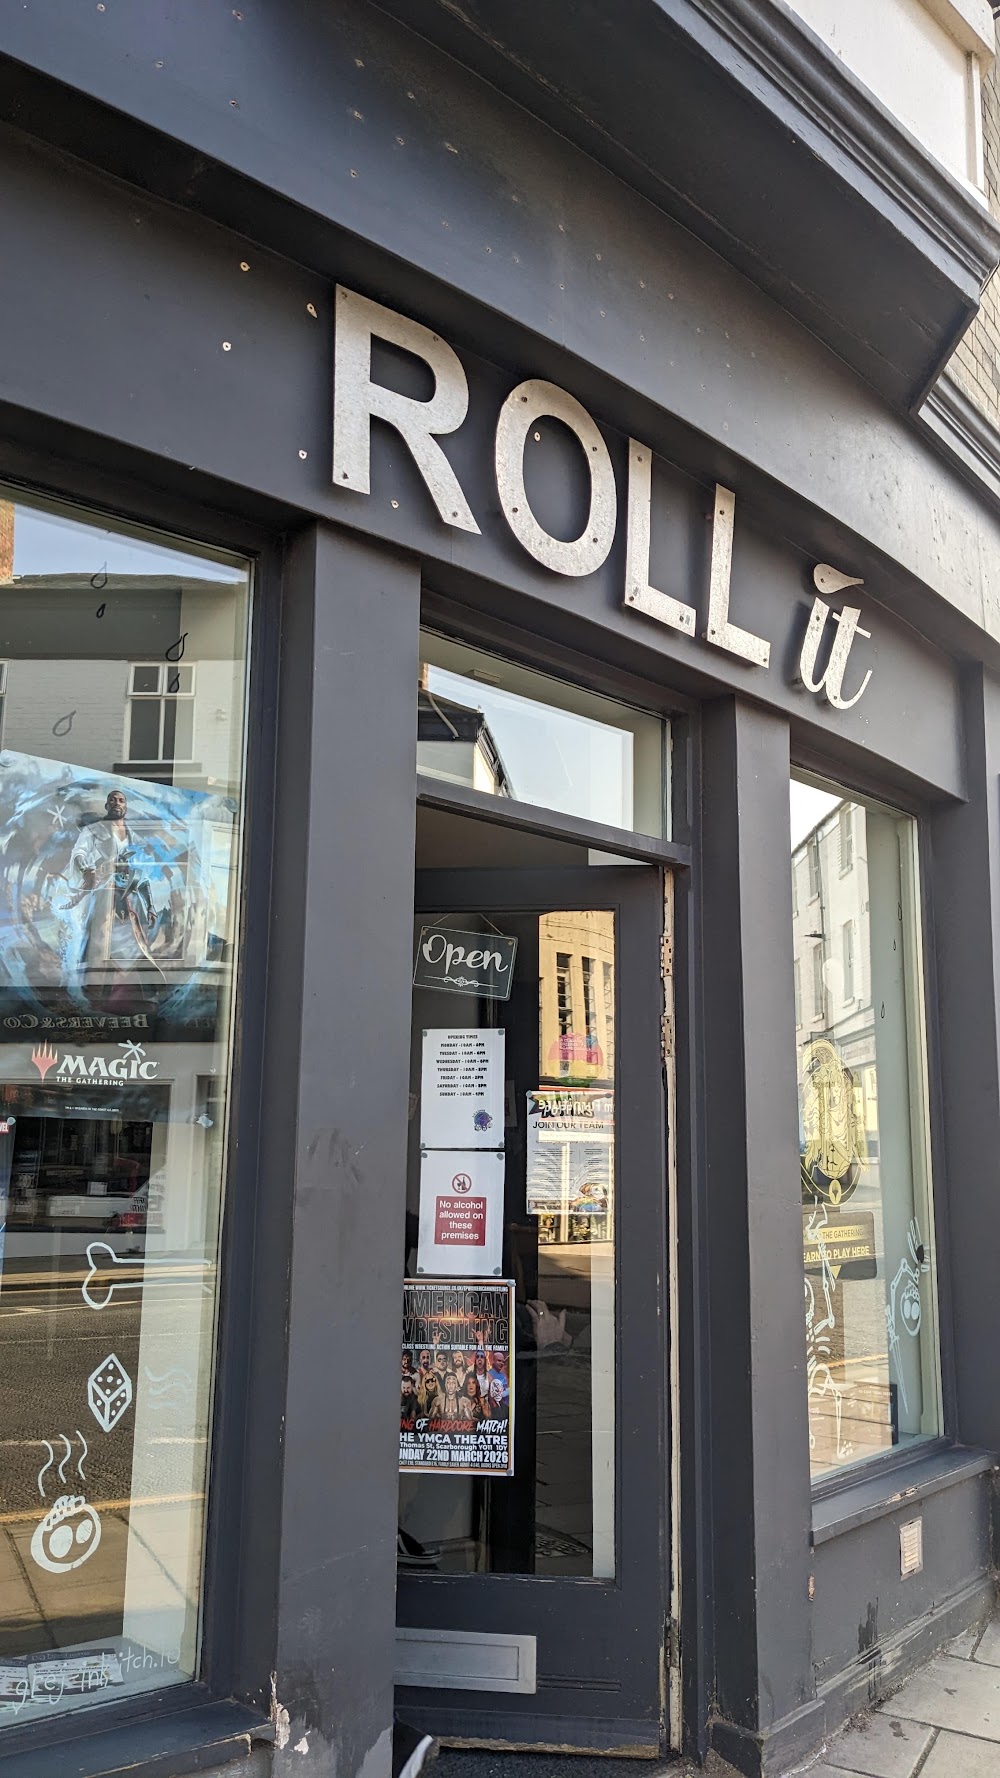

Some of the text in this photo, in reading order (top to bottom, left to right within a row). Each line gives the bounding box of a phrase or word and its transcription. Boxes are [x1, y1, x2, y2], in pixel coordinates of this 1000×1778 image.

[332, 283, 873, 710] ROLL it
[422, 934, 509, 974] Open
[56, 1055, 158, 1081] MAGIC
[75, 1077, 124, 1087] GATHERING
[532, 1121, 604, 1129] JOIN OUR TEAM
[439, 1200, 484, 1210] No alcohol
[439, 1211, 484, 1220] allowed on
[449, 1220, 473, 1230] these
[441, 1232, 480, 1241] premises
[822, 1231, 833, 1240] THE
[833, 1228, 865, 1239] GATHERING
[803, 1250, 821, 1262] ARN
[833, 1247, 851, 1260] PLAY
[851, 1245, 870, 1257] HERE
[400, 1418, 508, 1434] ING OF HARDCORE MATCH!
[400, 1432, 508, 1445] HE YMCA THEATRE
[400, 1441, 426, 1449] Thomas
[436, 1443, 477, 1452] Scarborough
[399, 1449, 509, 1464] NDAY 22ND MARCH 2026
